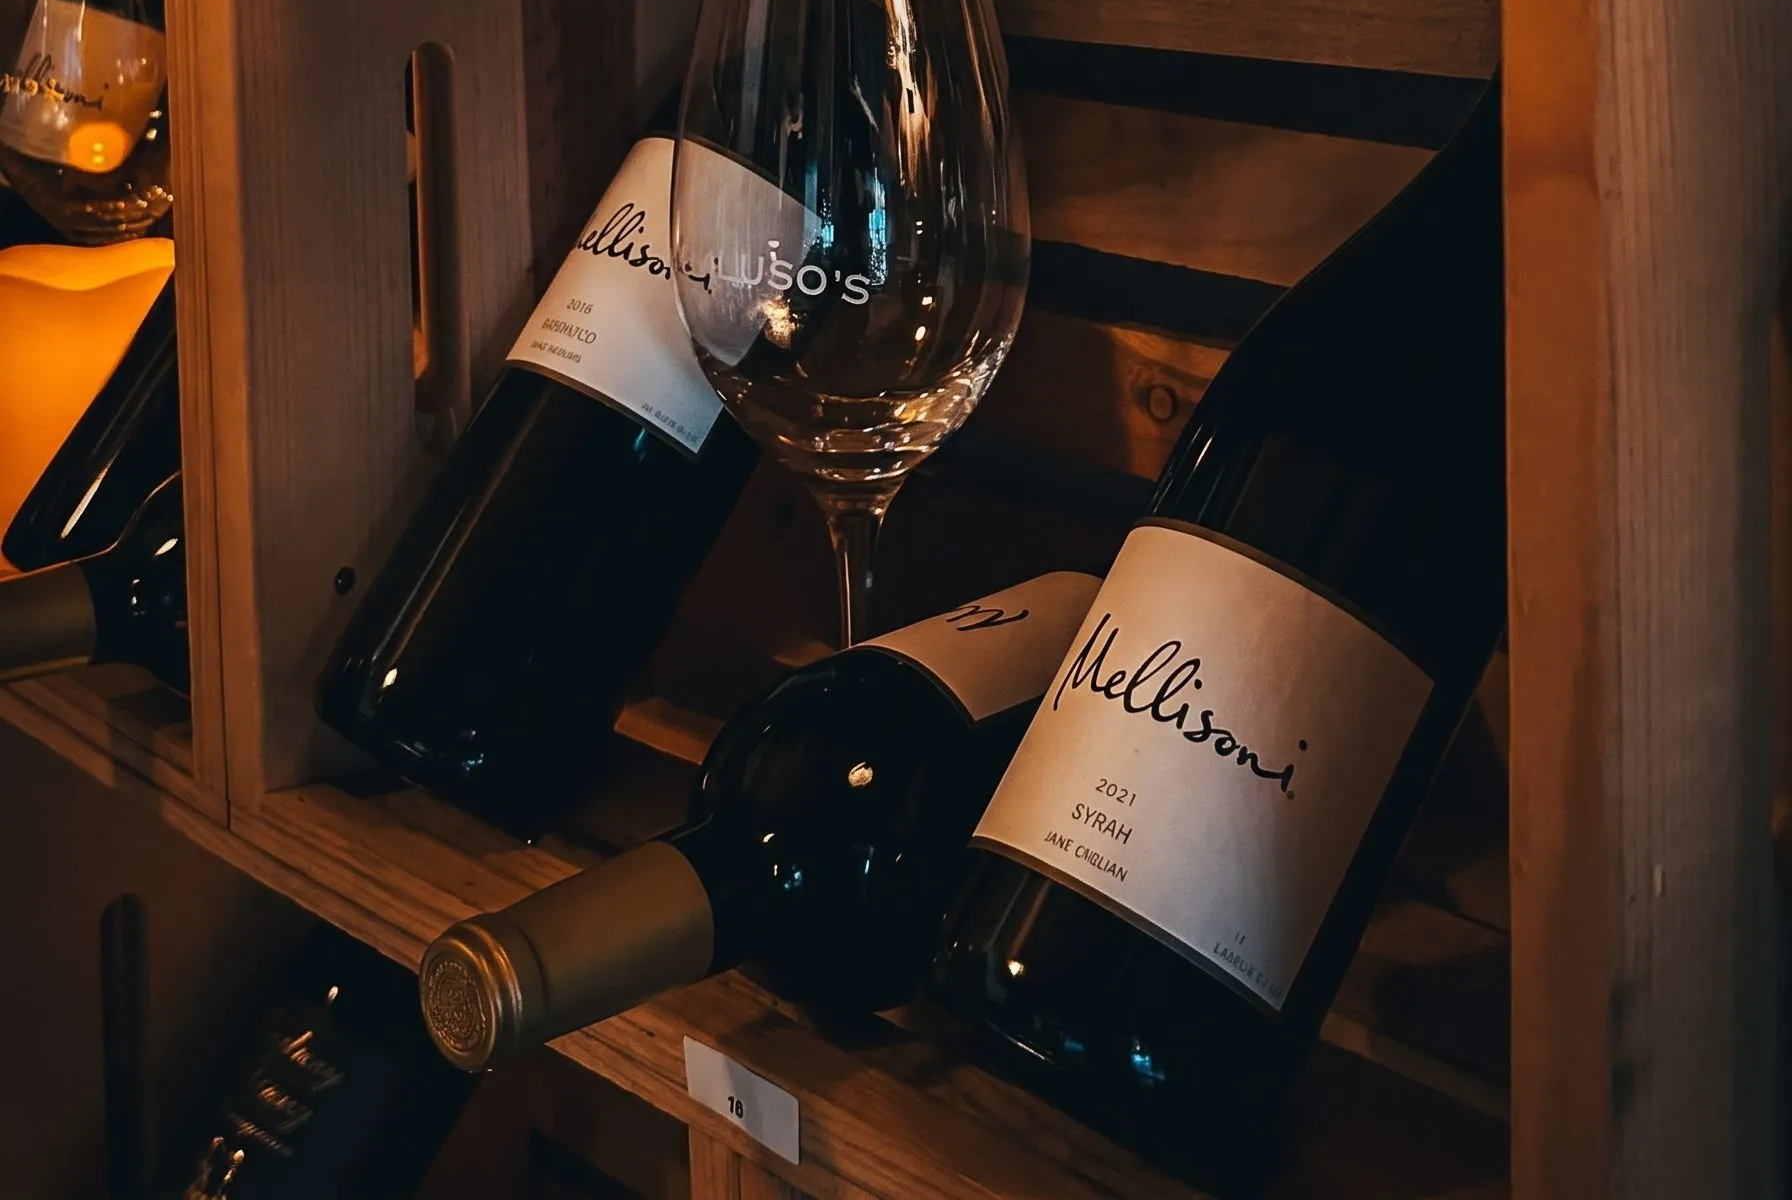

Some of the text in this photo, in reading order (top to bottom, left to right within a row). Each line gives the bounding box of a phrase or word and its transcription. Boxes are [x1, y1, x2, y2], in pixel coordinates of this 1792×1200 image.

[1095, 778, 1137, 807] 2021
[1071, 802, 1133, 845] SYRAH
[1043, 830, 1074, 852] JANE
